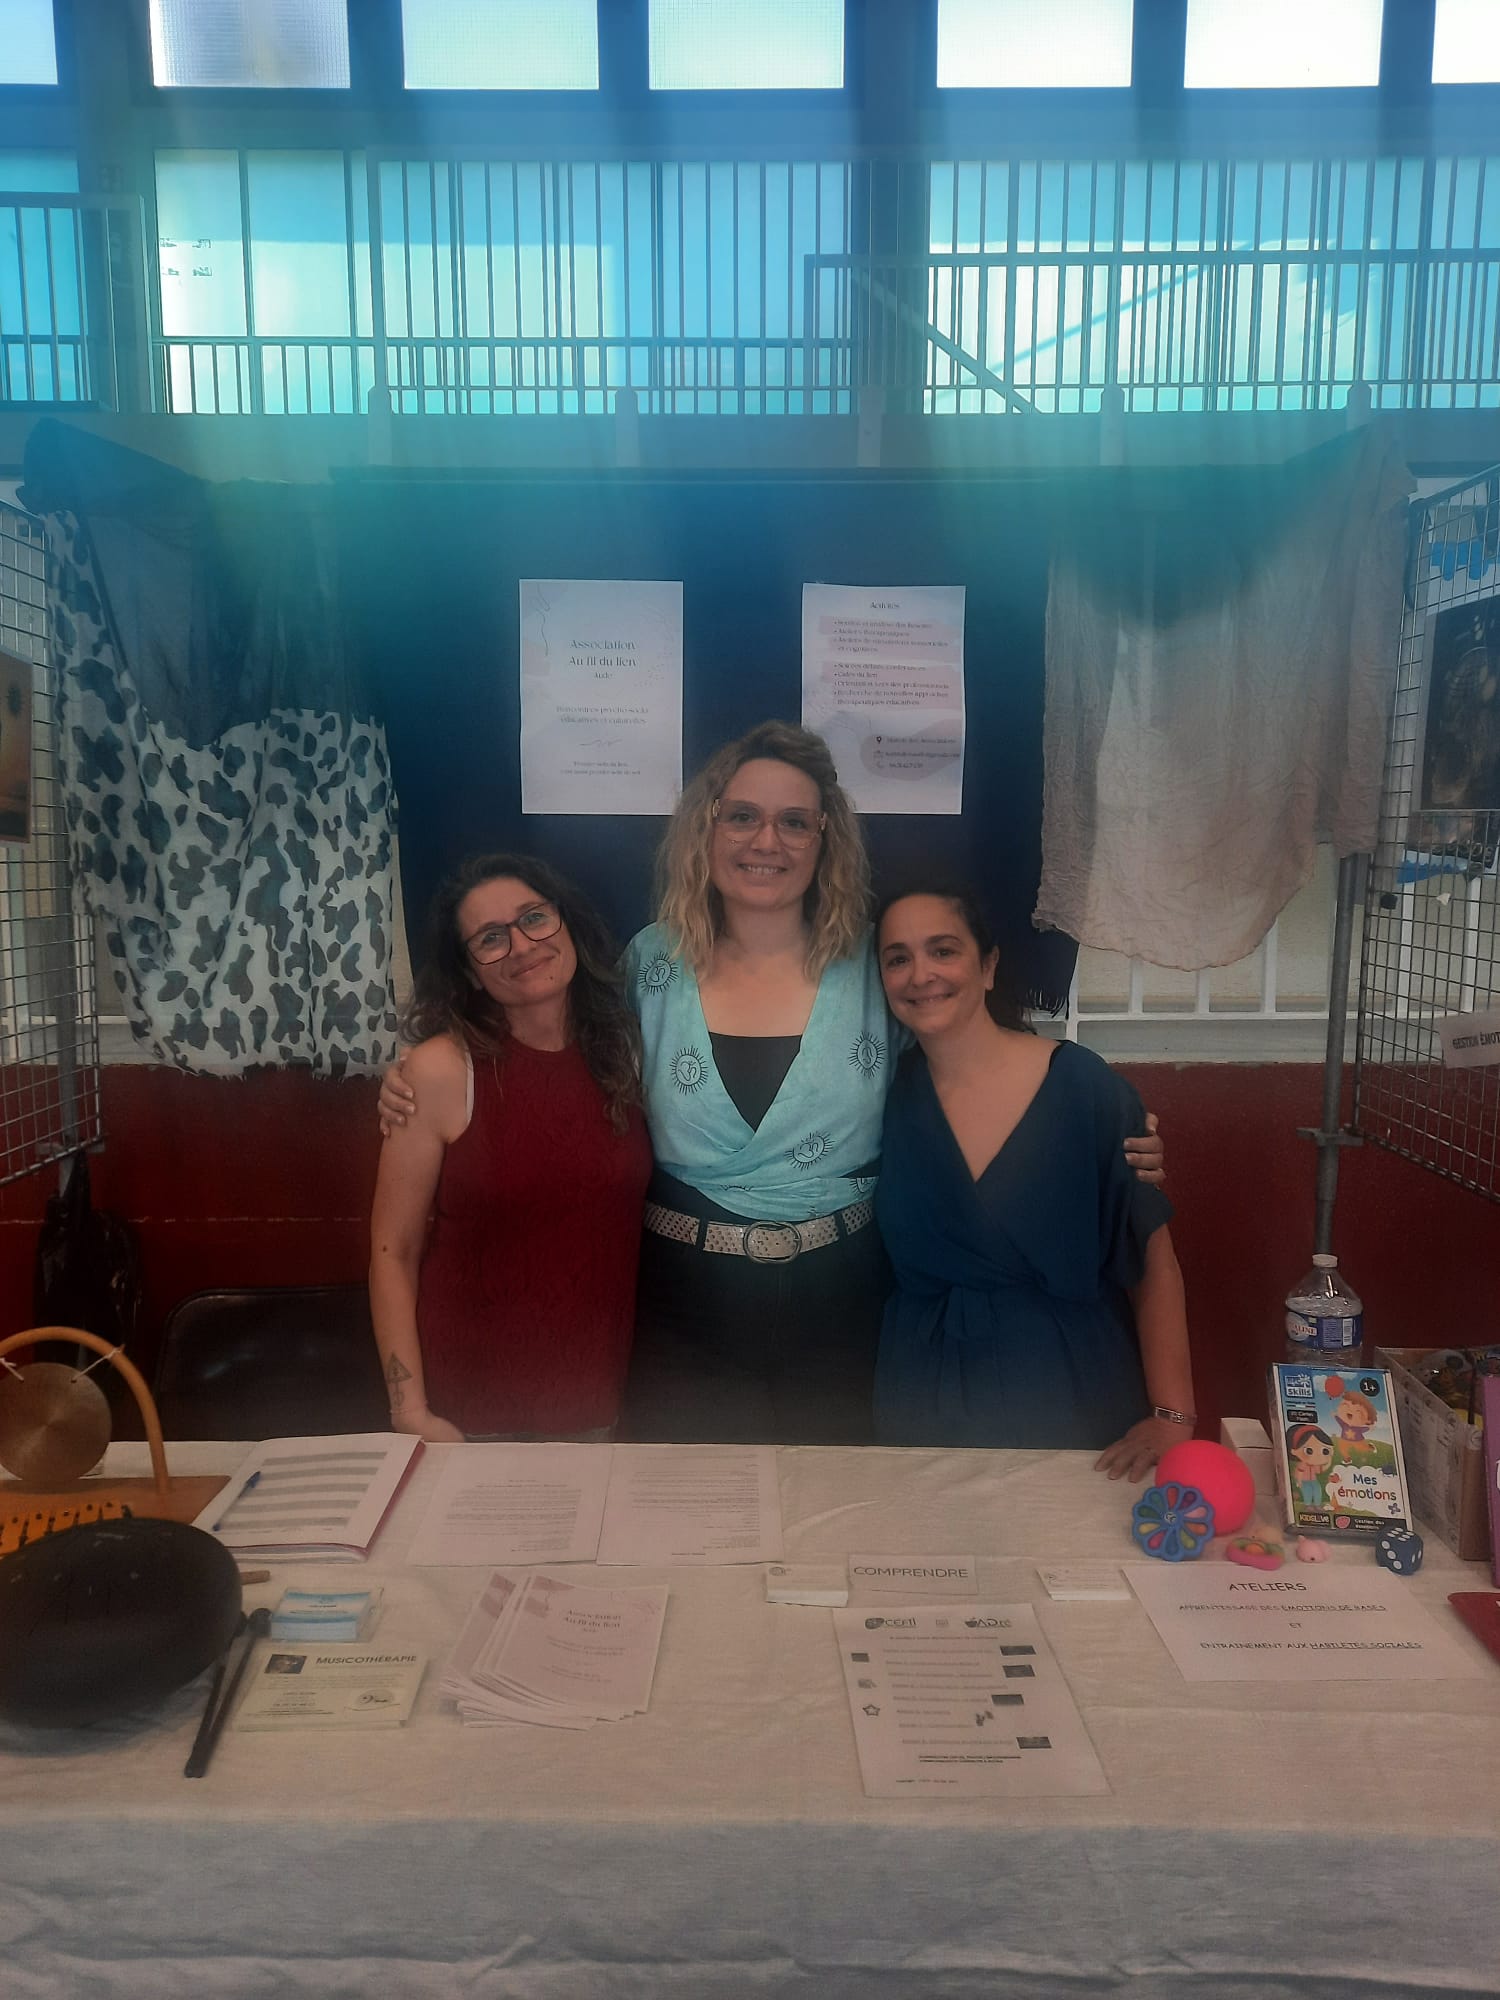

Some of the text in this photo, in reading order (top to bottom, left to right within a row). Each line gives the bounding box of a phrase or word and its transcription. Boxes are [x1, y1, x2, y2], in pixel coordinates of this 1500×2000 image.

[569, 640, 636, 650] Association
[569, 656, 637, 666] Au fil du lien
[1362, 1381, 1377, 1392] 1+
[1288, 1388, 1312, 1397] Skills
[1354, 1474, 1378, 1486] Mes
[1338, 1486, 1396, 1501] émotions
[854, 1566, 968, 1578] COMPRENDRE
[1229, 1582, 1306, 1592] ATELIERS
